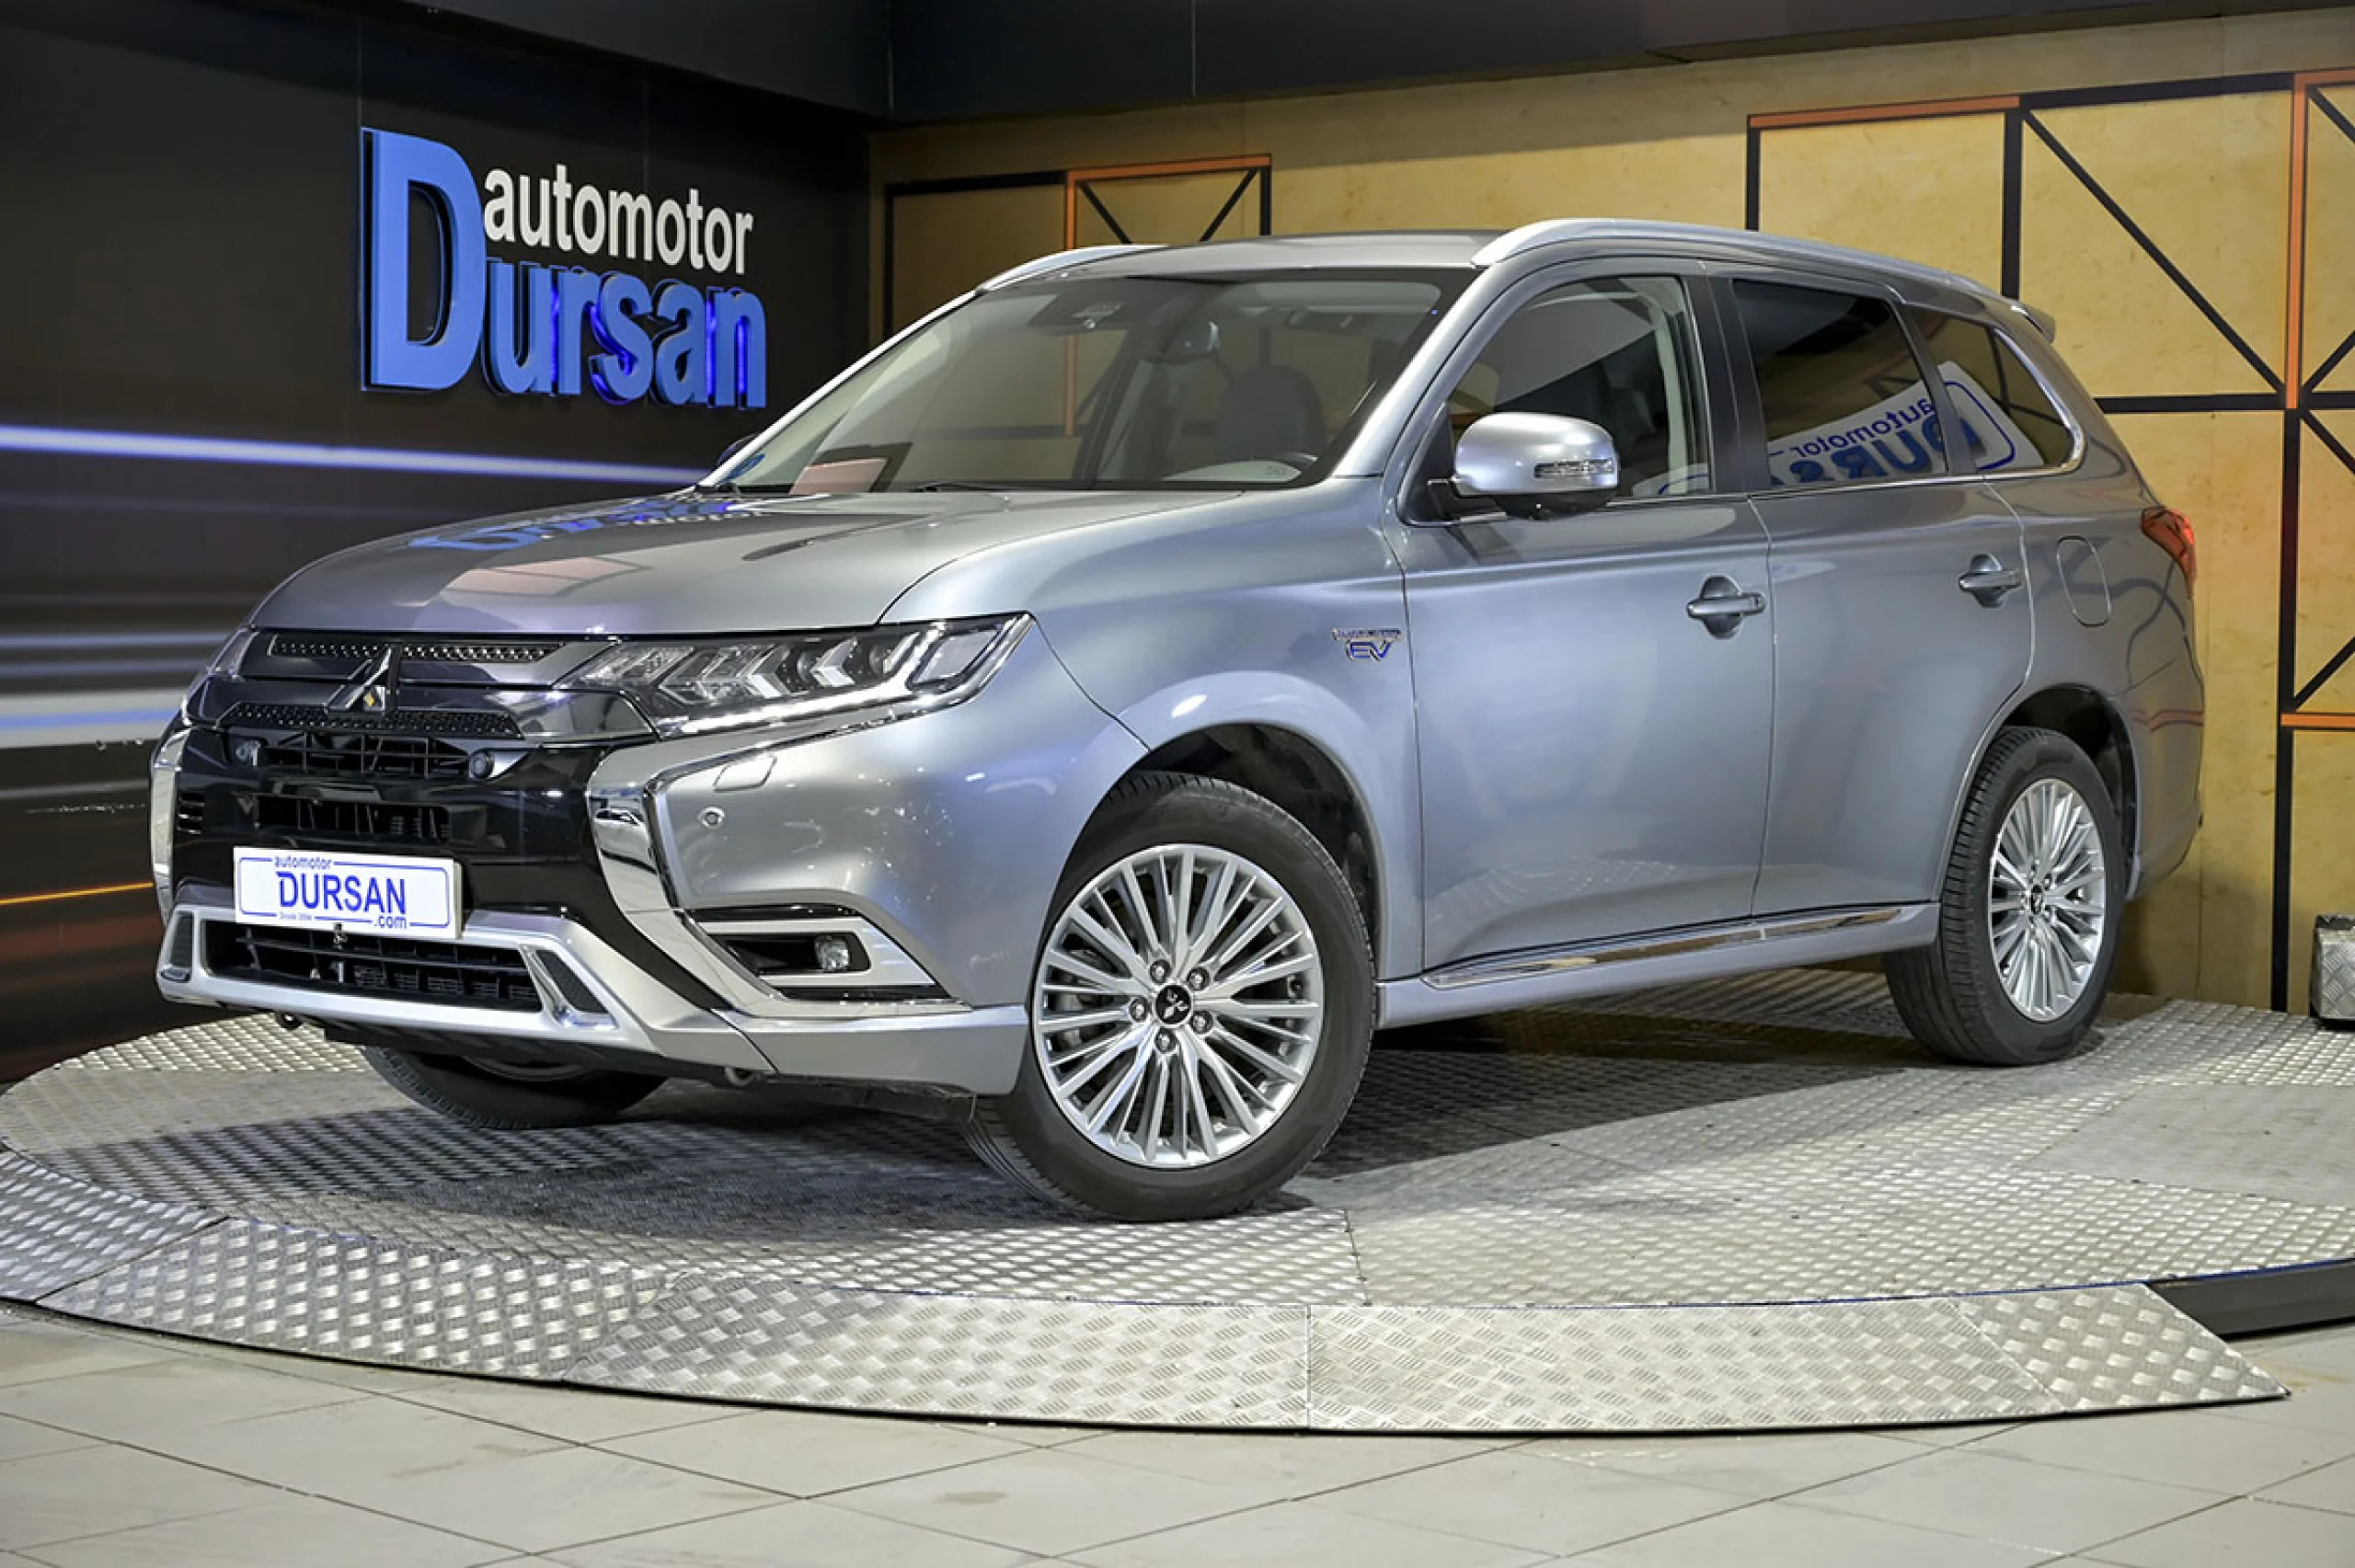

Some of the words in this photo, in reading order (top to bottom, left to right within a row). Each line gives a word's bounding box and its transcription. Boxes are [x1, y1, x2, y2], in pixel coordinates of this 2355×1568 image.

[484, 164, 752, 273] automotor
[362, 127, 766, 409] Dursan
[1350, 641, 1393, 659] EV
[274, 855, 332, 870] automotor
[276, 870, 407, 915] DURSAN
